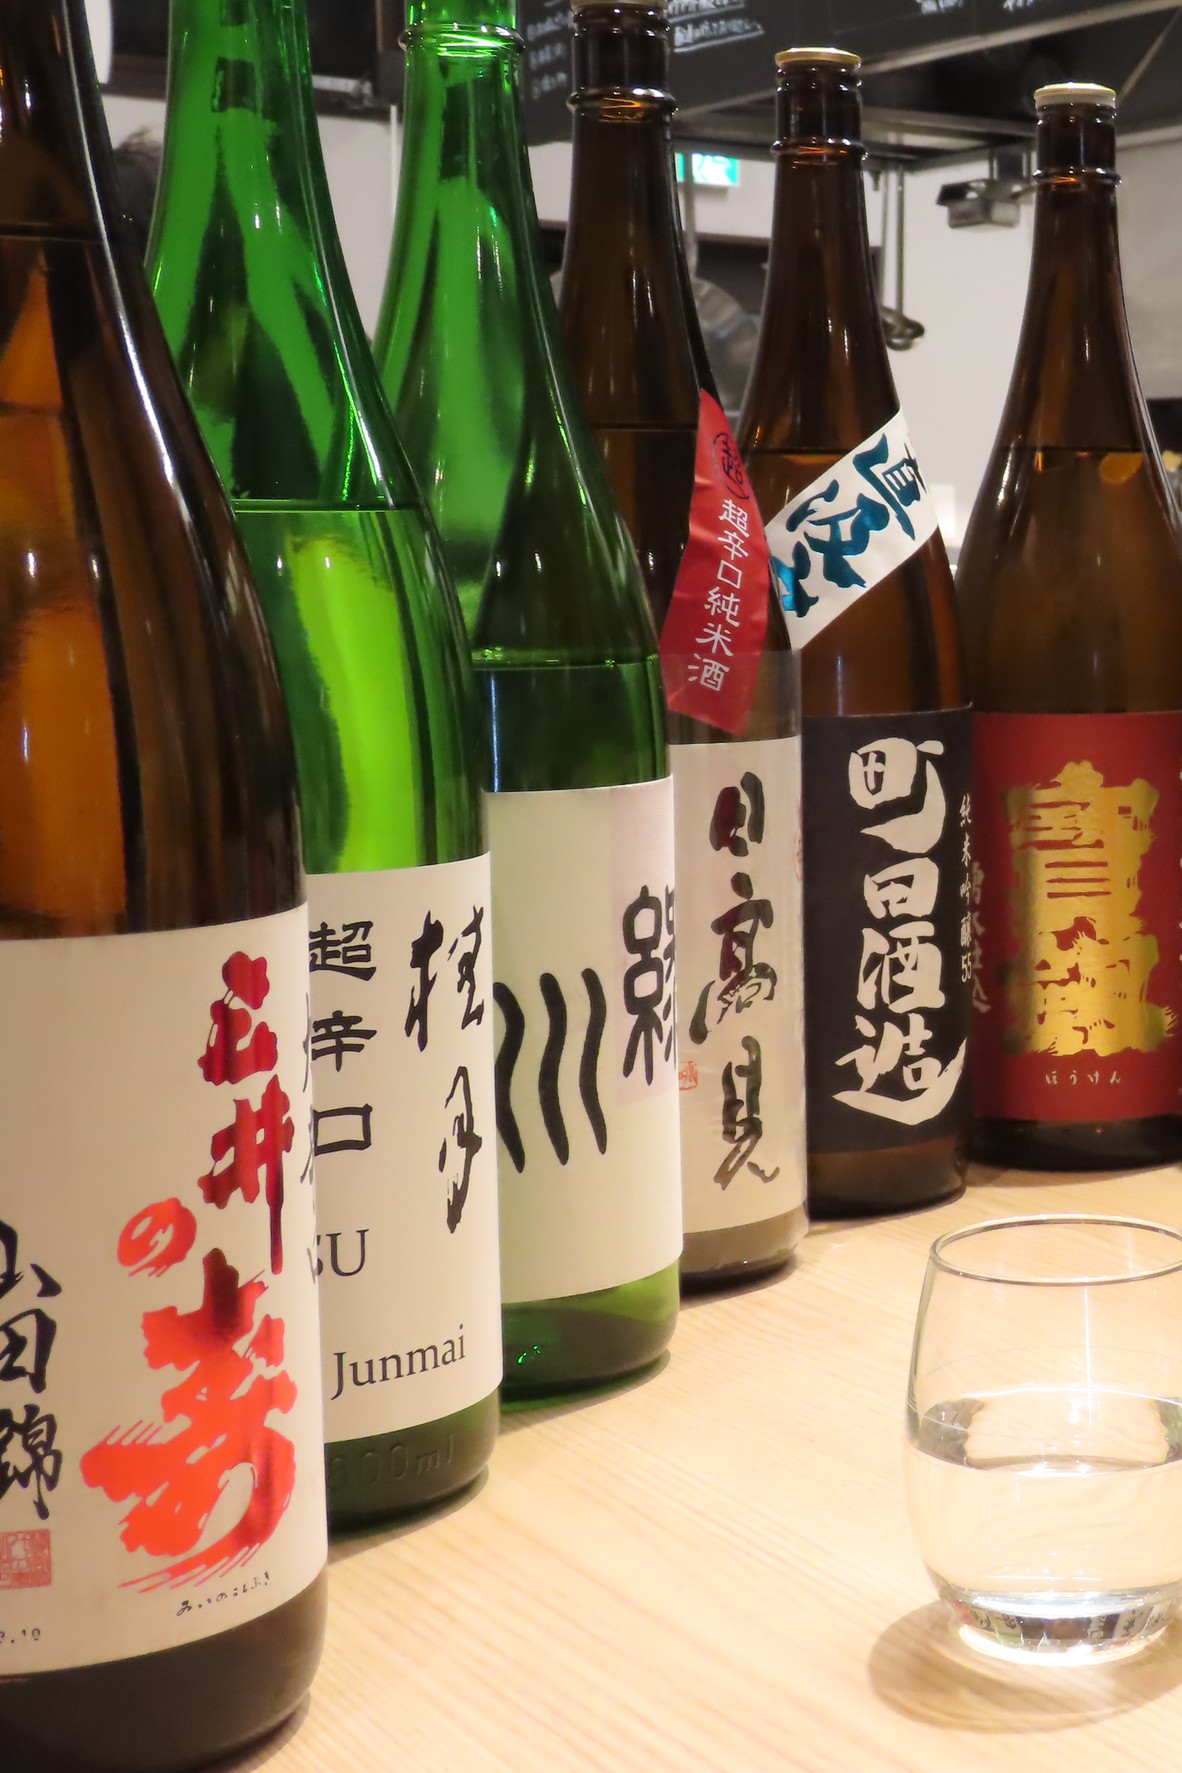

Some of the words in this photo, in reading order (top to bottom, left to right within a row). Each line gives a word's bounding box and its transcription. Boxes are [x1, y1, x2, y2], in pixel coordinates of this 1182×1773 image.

[687, 498, 750, 692] 超辛口純米酒
[309, 920, 377, 1157] 超辛口
[832, 736, 968, 1127] 町田酒造
[331, 1322, 467, 1402] Junmai
